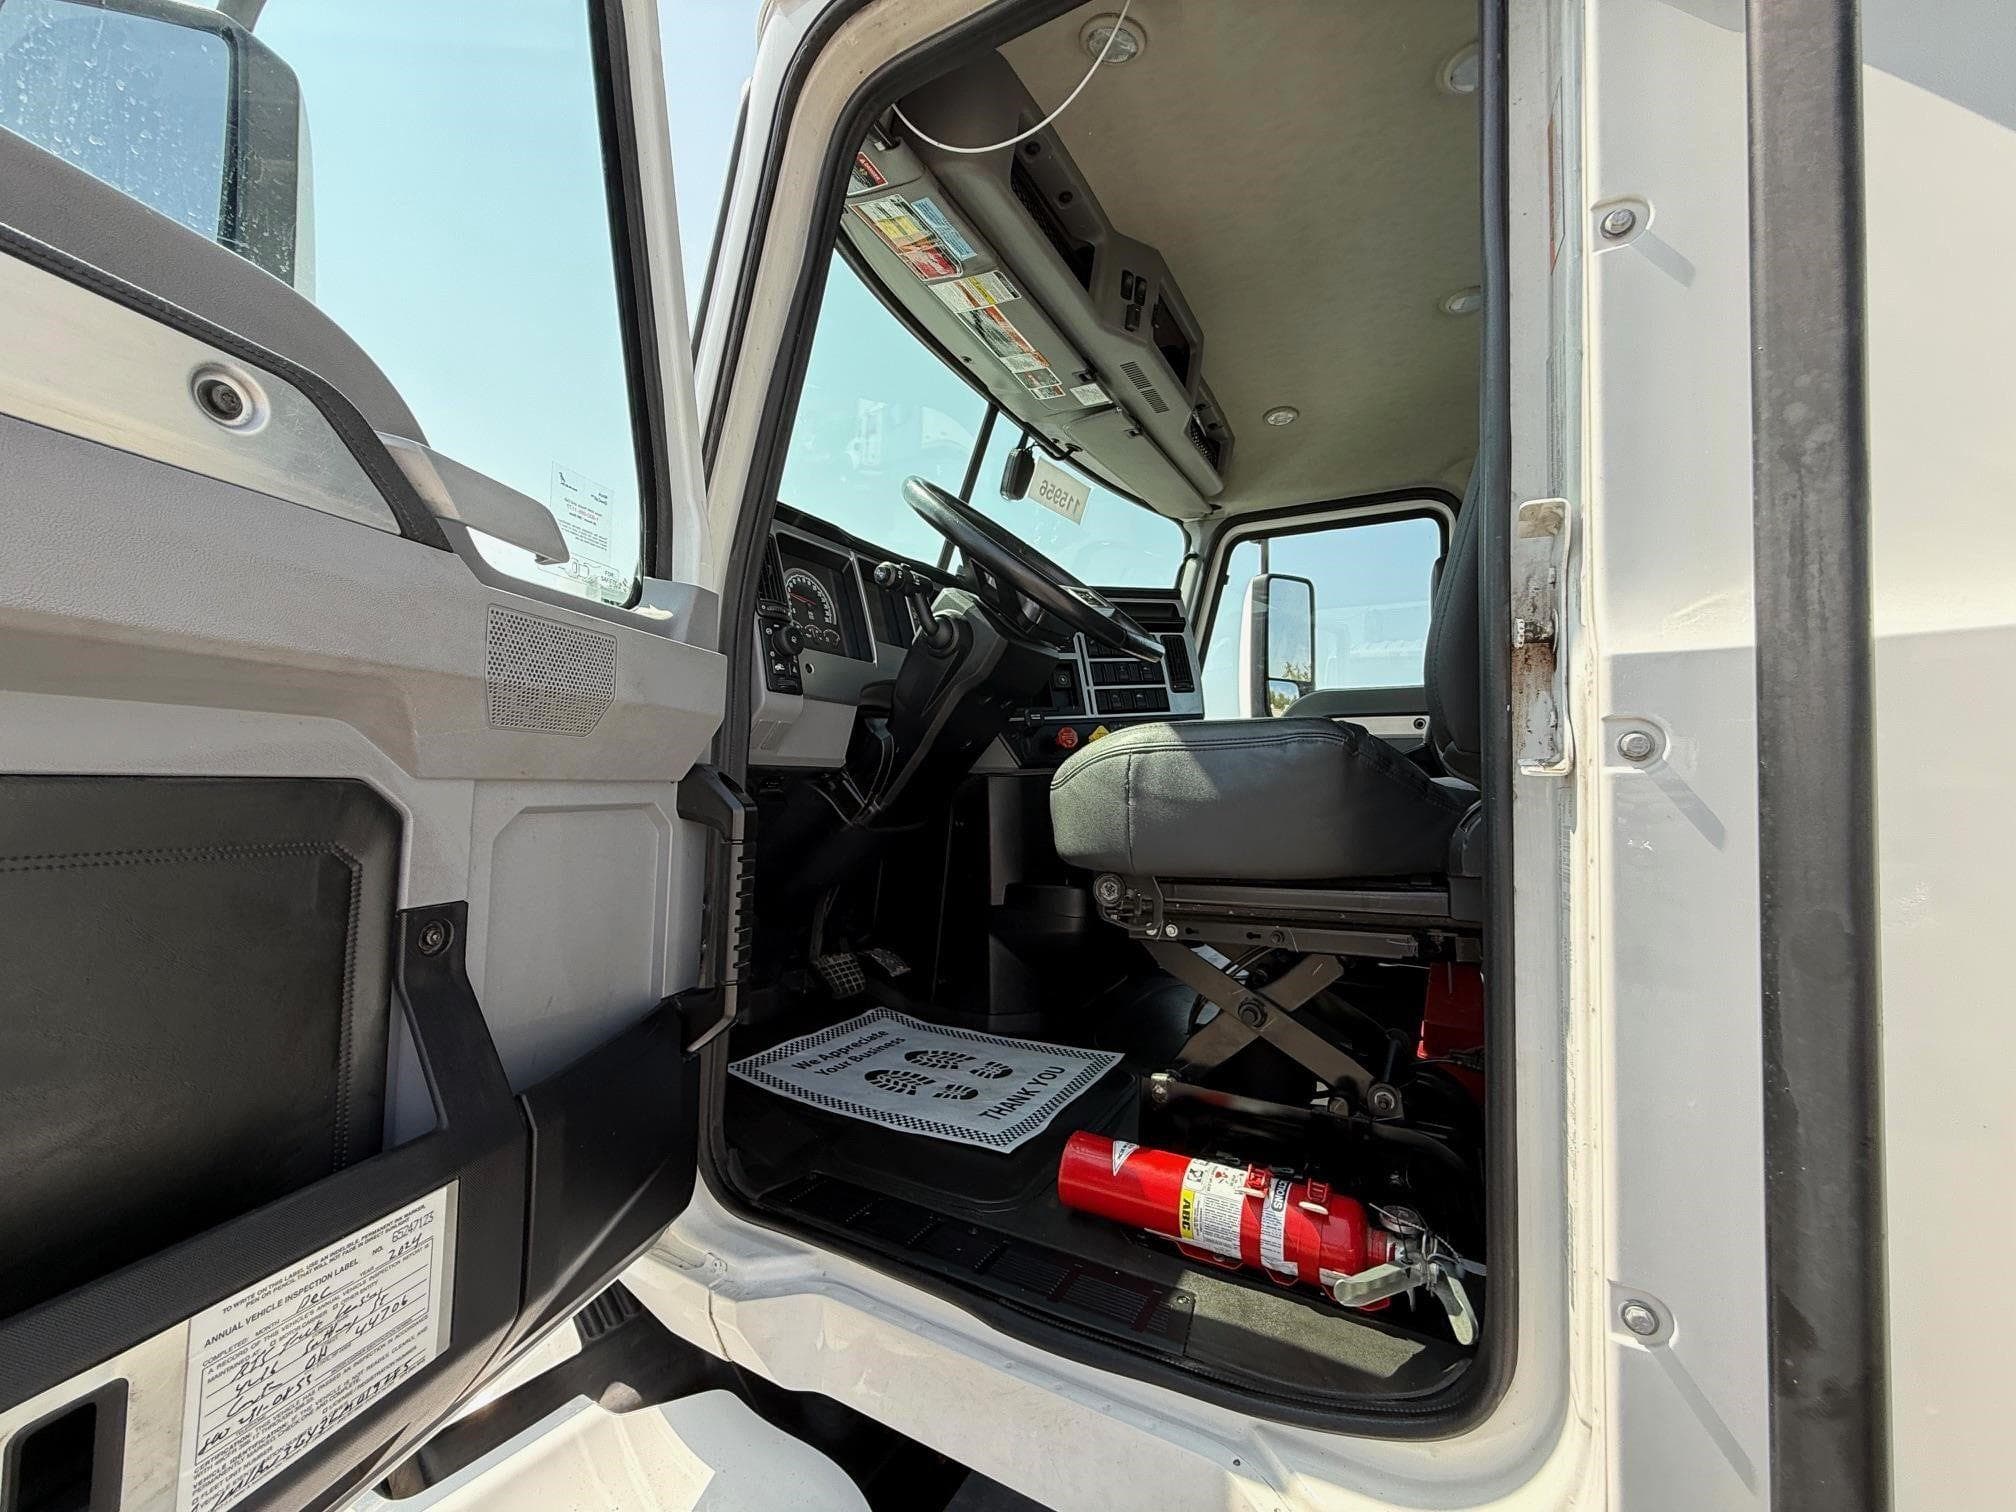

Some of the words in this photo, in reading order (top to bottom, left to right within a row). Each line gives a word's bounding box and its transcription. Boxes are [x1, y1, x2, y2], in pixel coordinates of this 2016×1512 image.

[792, 1060, 821, 1069] We
[819, 1030, 889, 1060] Appreciate
[815, 1061, 852, 1075] Your
[848, 1037, 906, 1062] Business
[978, 1087, 1041, 1120] THANK
[1027, 1066, 1065, 1086] YOU
[1182, 1198, 1191, 1231] ABC
[204, 1318, 243, 1348] ANNUAL
[244, 1297, 283, 1326] VEHICLE
[284, 1270, 332, 1304] INSPECTION
[334, 1256, 358, 1277] LABEL
[255, 1319, 279, 1337] MONTH
[387, 1232, 422, 1264] 2024
[354, 1293, 407, 1339] 44706
[216, 1346, 248, 1369] RECORD
[264, 1328, 278, 1342] THIS
